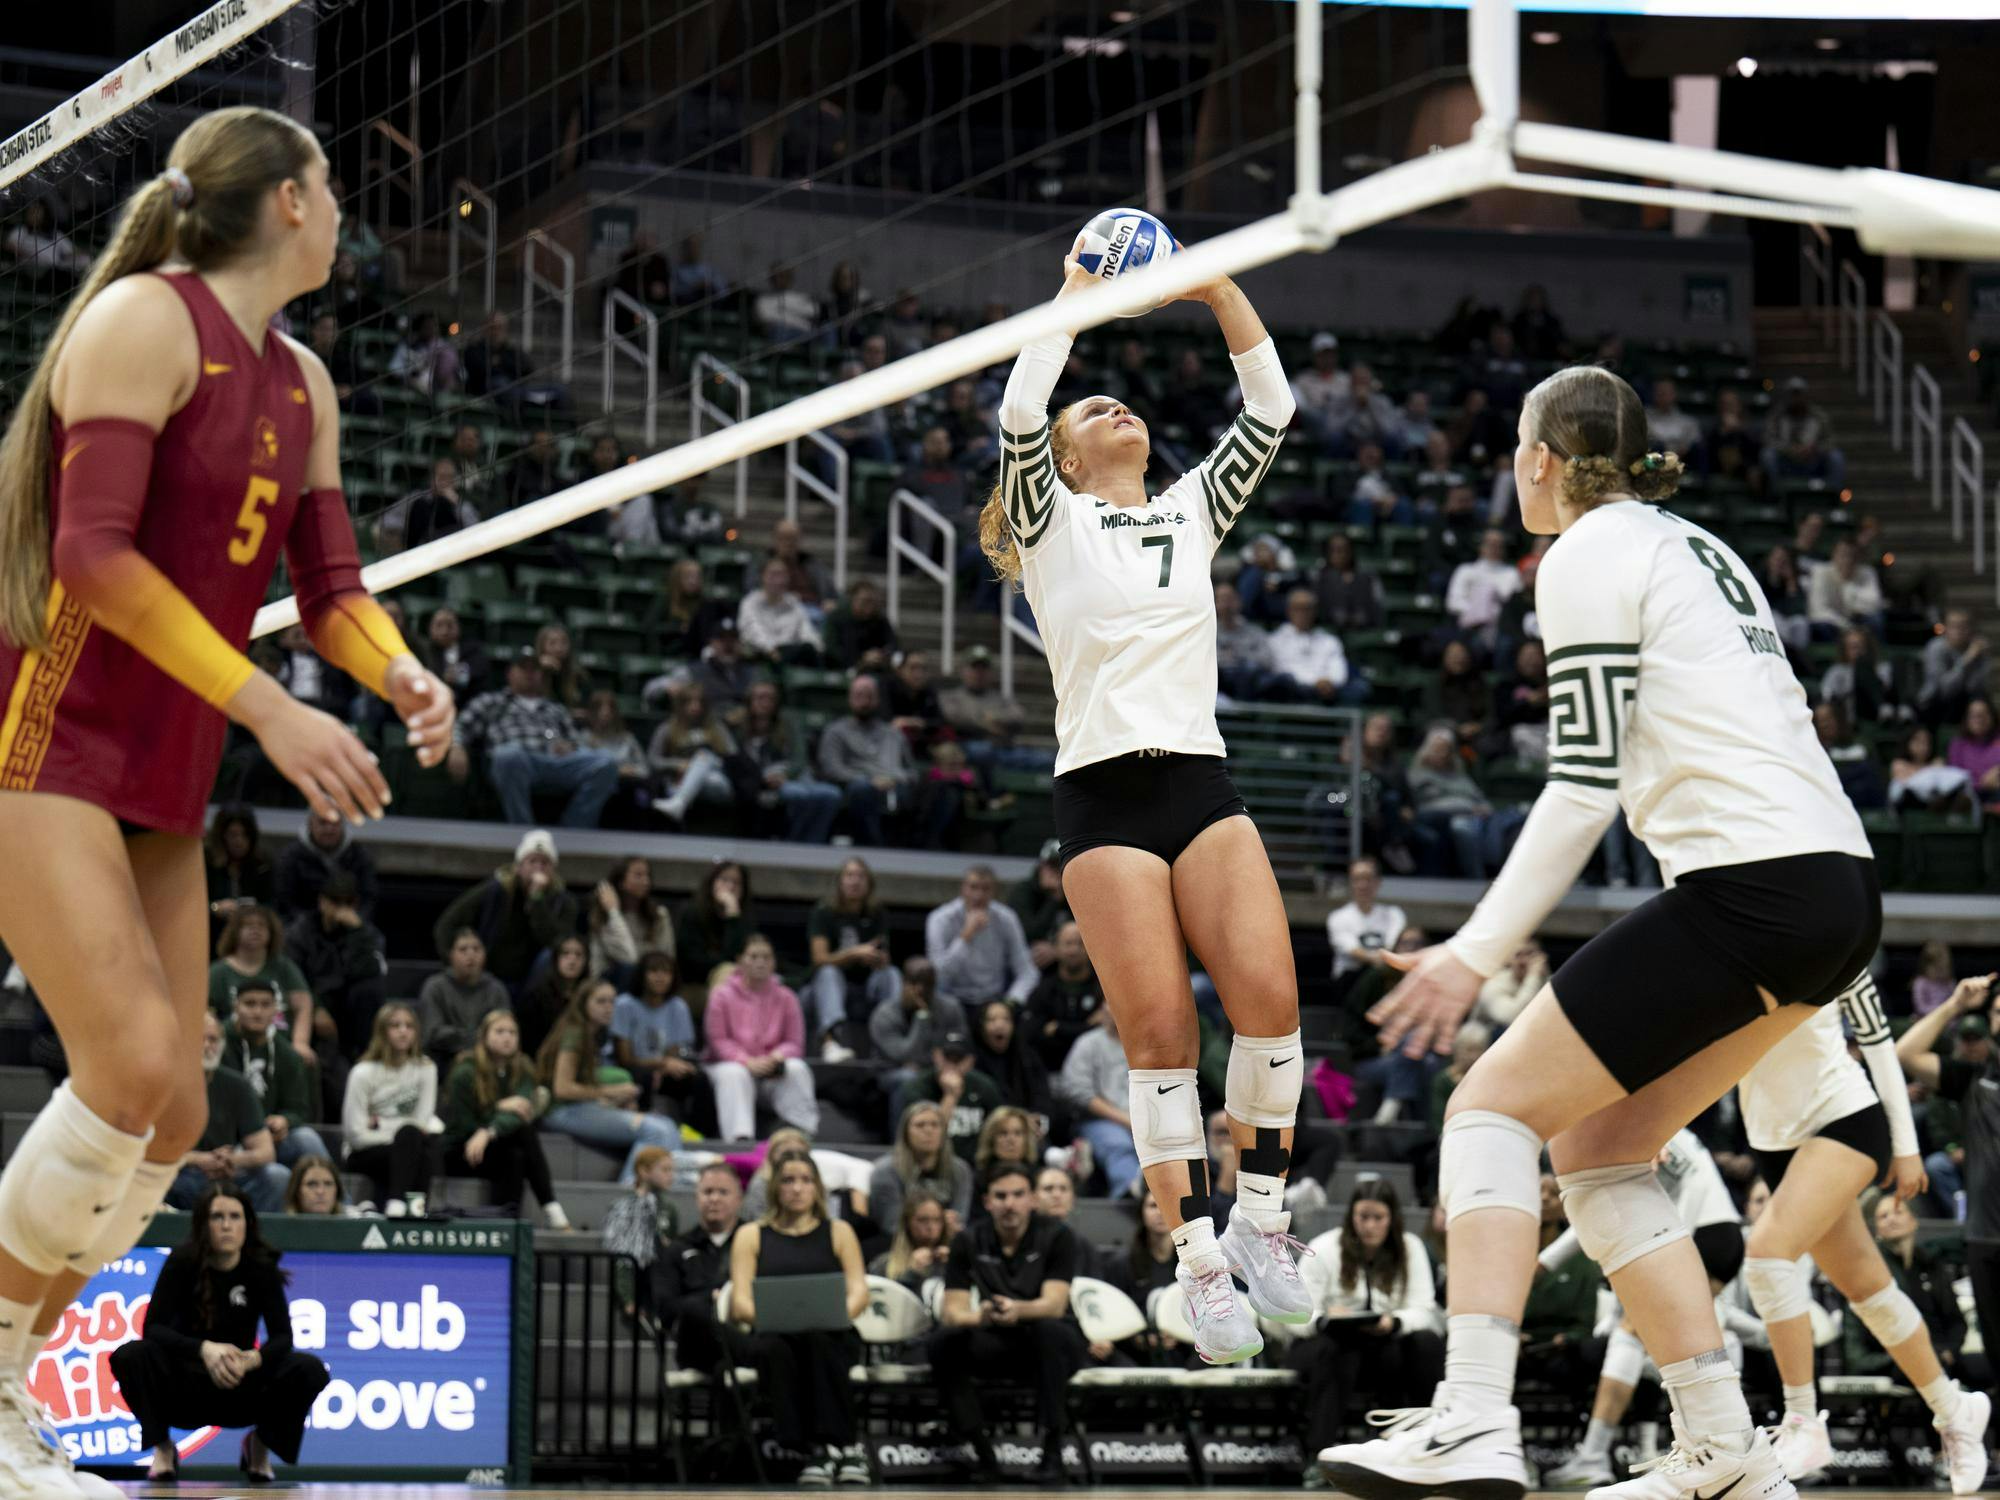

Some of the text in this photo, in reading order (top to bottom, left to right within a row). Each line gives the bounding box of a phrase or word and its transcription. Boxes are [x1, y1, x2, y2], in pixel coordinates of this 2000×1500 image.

[28, 117, 52, 151] STATE
[1102, 225, 1133, 280] molten
[227, 474, 280, 567] 5
[1142, 534, 1174, 588] 7
[1686, 536, 1757, 617] 8
[289, 1284, 466, 1352] a sub
[61, 1424, 143, 1461] SUBS
[1109, 1441, 1189, 1464] Rocket
